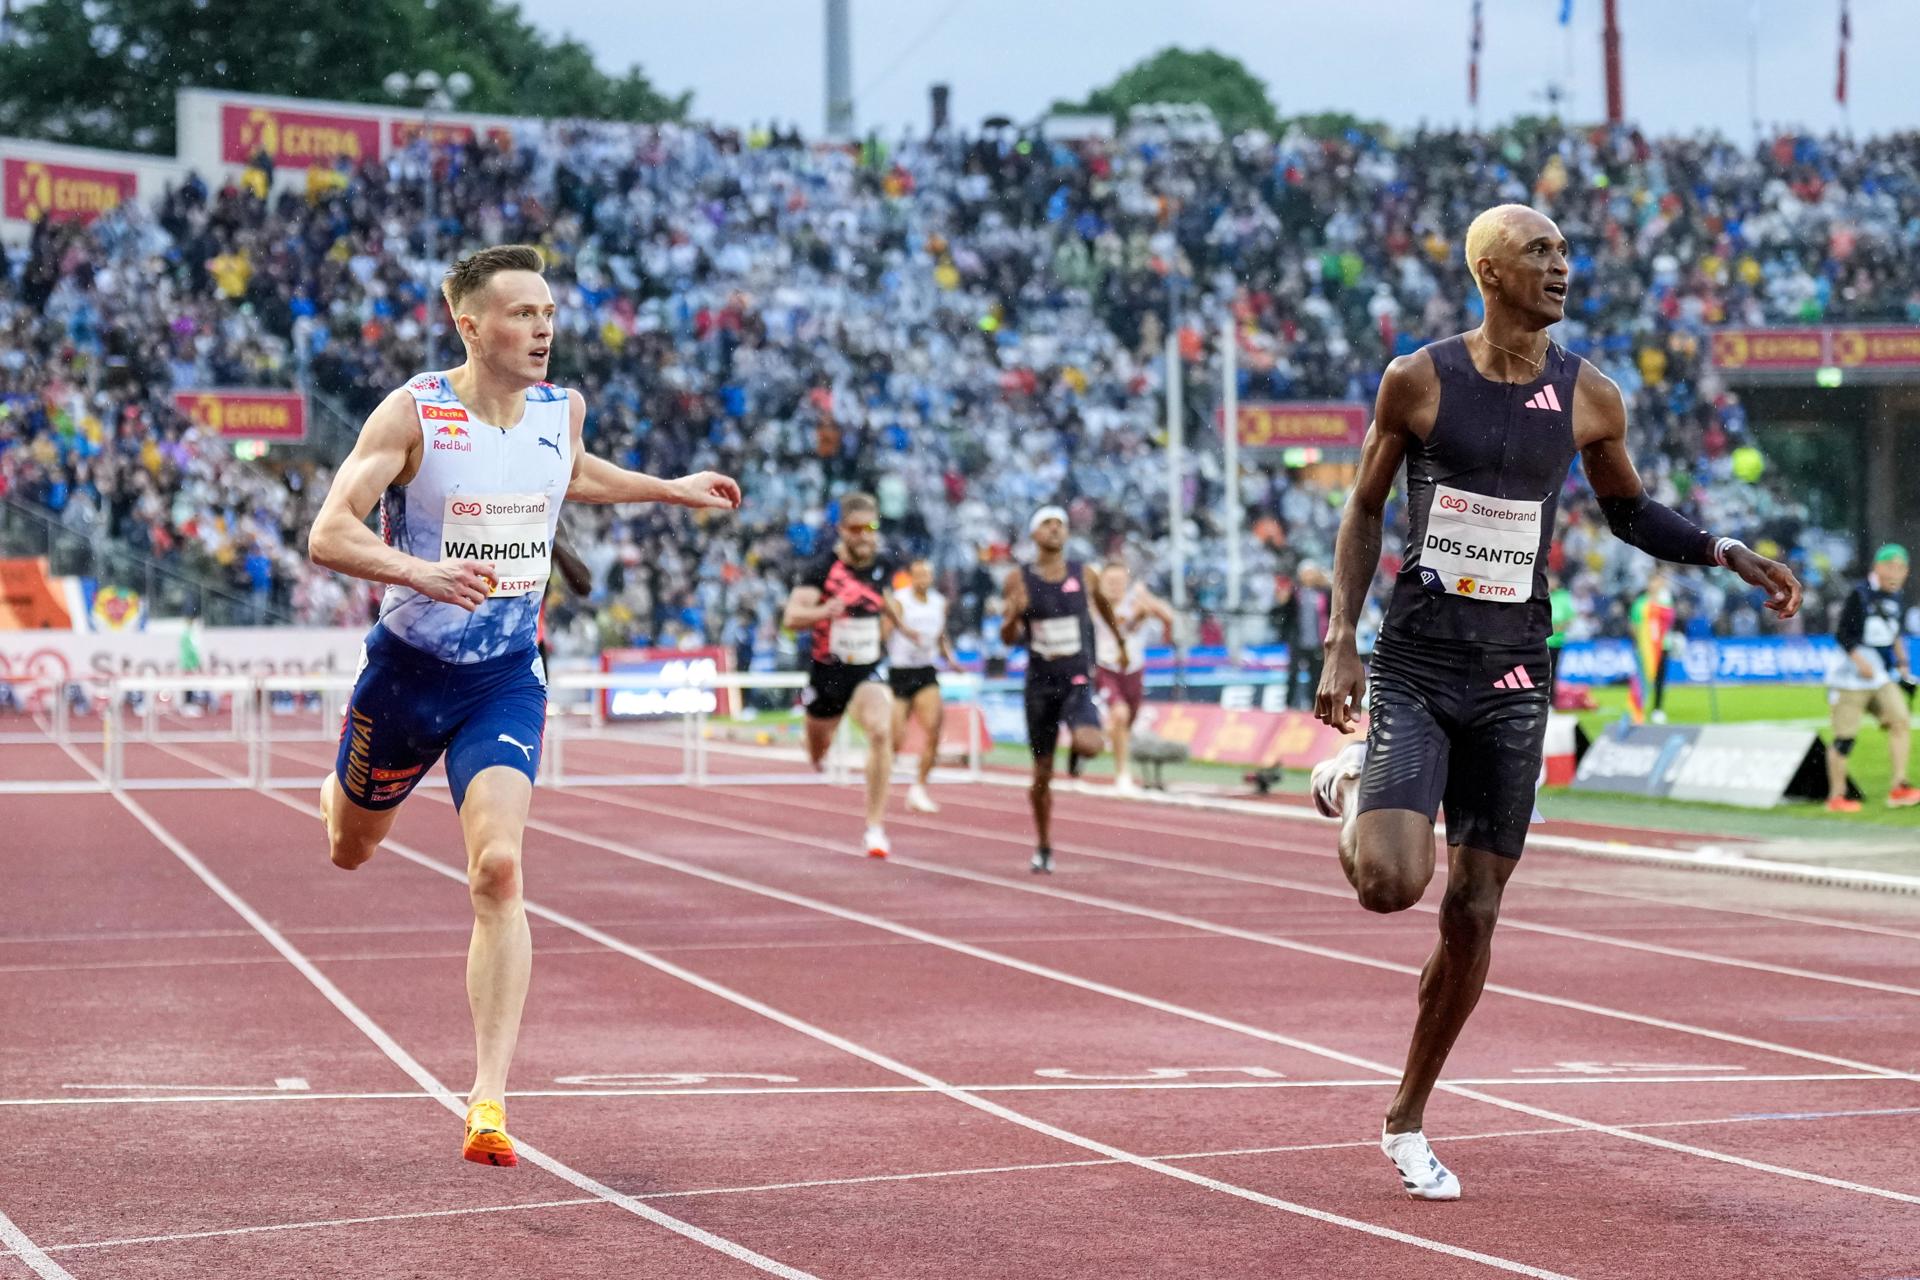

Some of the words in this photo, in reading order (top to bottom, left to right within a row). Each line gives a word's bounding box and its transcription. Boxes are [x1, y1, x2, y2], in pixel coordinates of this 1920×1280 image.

[283, 124, 361, 158] EXTRA
[439, 410, 465, 418] EXTRA
[433, 440, 453, 449] Red
[454, 441, 472, 452] Bull
[485, 501, 546, 515] Storebrand
[1471, 503, 1537, 523] Storebrand
[444, 540, 547, 561] WARHOLM
[1426, 534, 1462, 556] DOS
[1465, 543, 1535, 566] SANTOS
[1478, 585, 1517, 596] EXTRA
[90, 651, 336, 684] Storbrand
[345, 706, 373, 798] NORWAY
